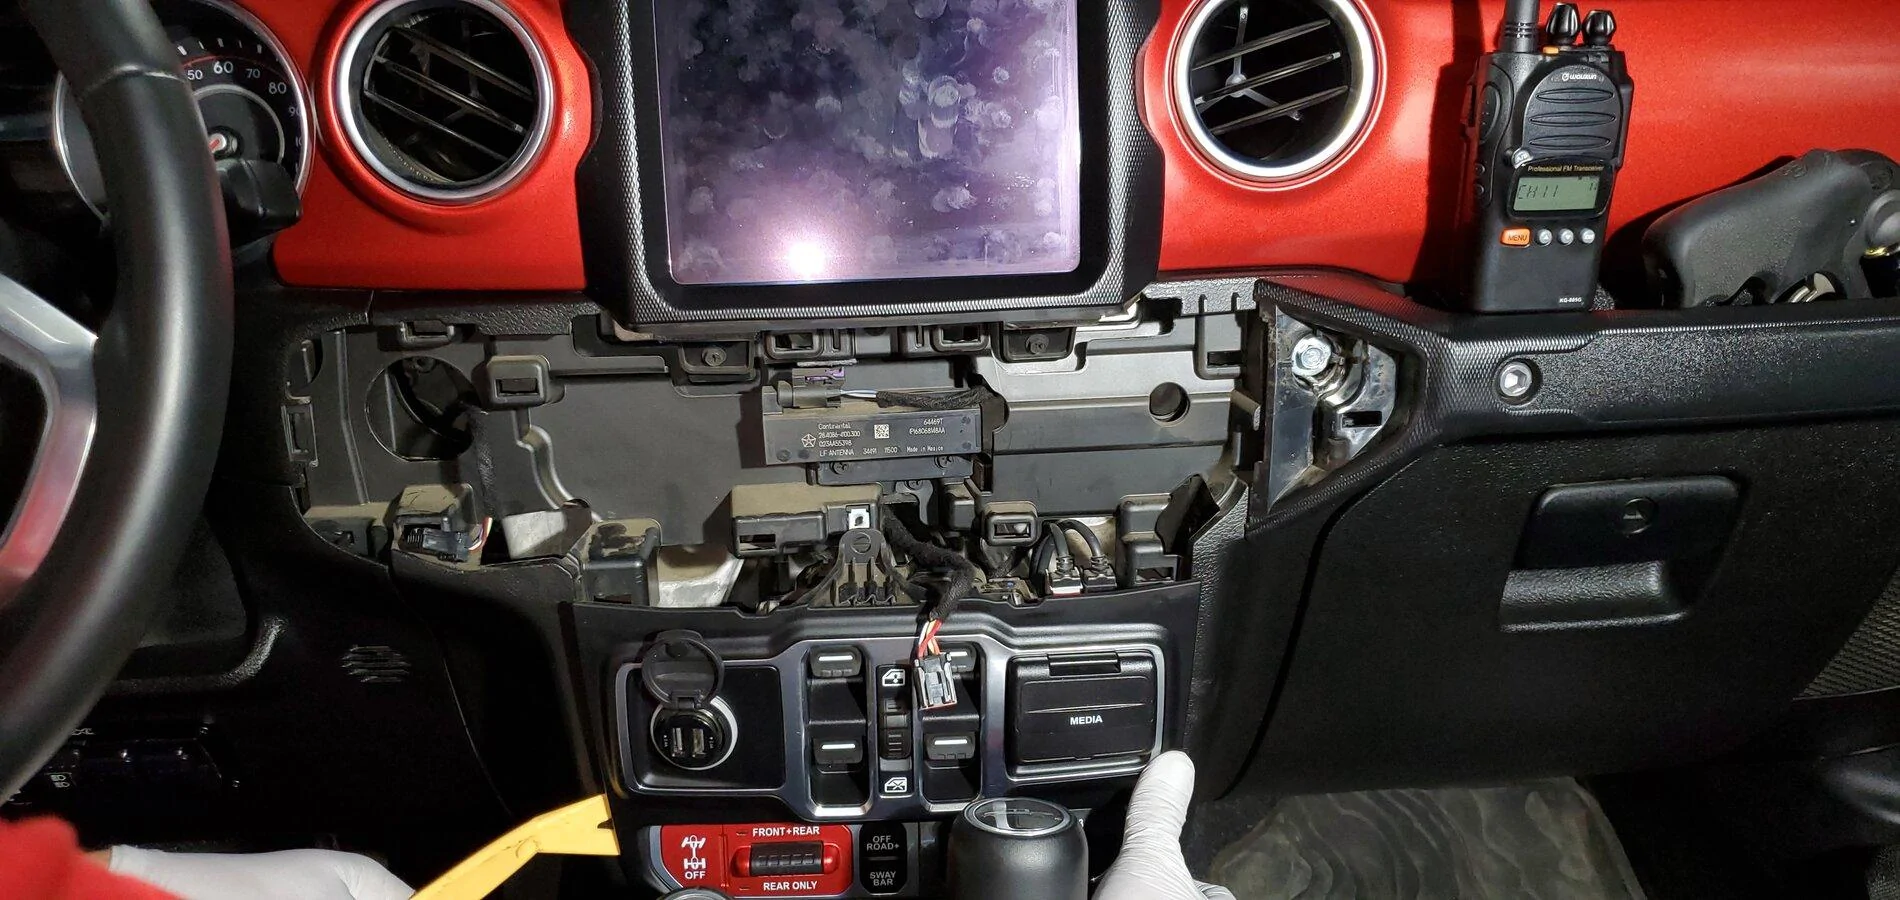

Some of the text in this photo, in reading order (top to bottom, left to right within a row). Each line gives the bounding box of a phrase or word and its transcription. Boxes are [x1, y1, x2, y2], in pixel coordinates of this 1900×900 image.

[213, 61, 234, 74] 60
[187, 69, 203, 80] 50
[246, 68, 261, 79] 70
[268, 81, 287, 95] 80
[828, 448, 855, 456] ANTENNA
[1069, 714, 1103, 725] MEDIA
[872, 835, 892, 844] OFF
[866, 842, 900, 851] ROAD+
[684, 870, 706, 880] OFF
[869, 871, 896, 880] SWAY
[763, 881, 818, 891] REAR ONLY
[873, 878, 894, 887] BAR
